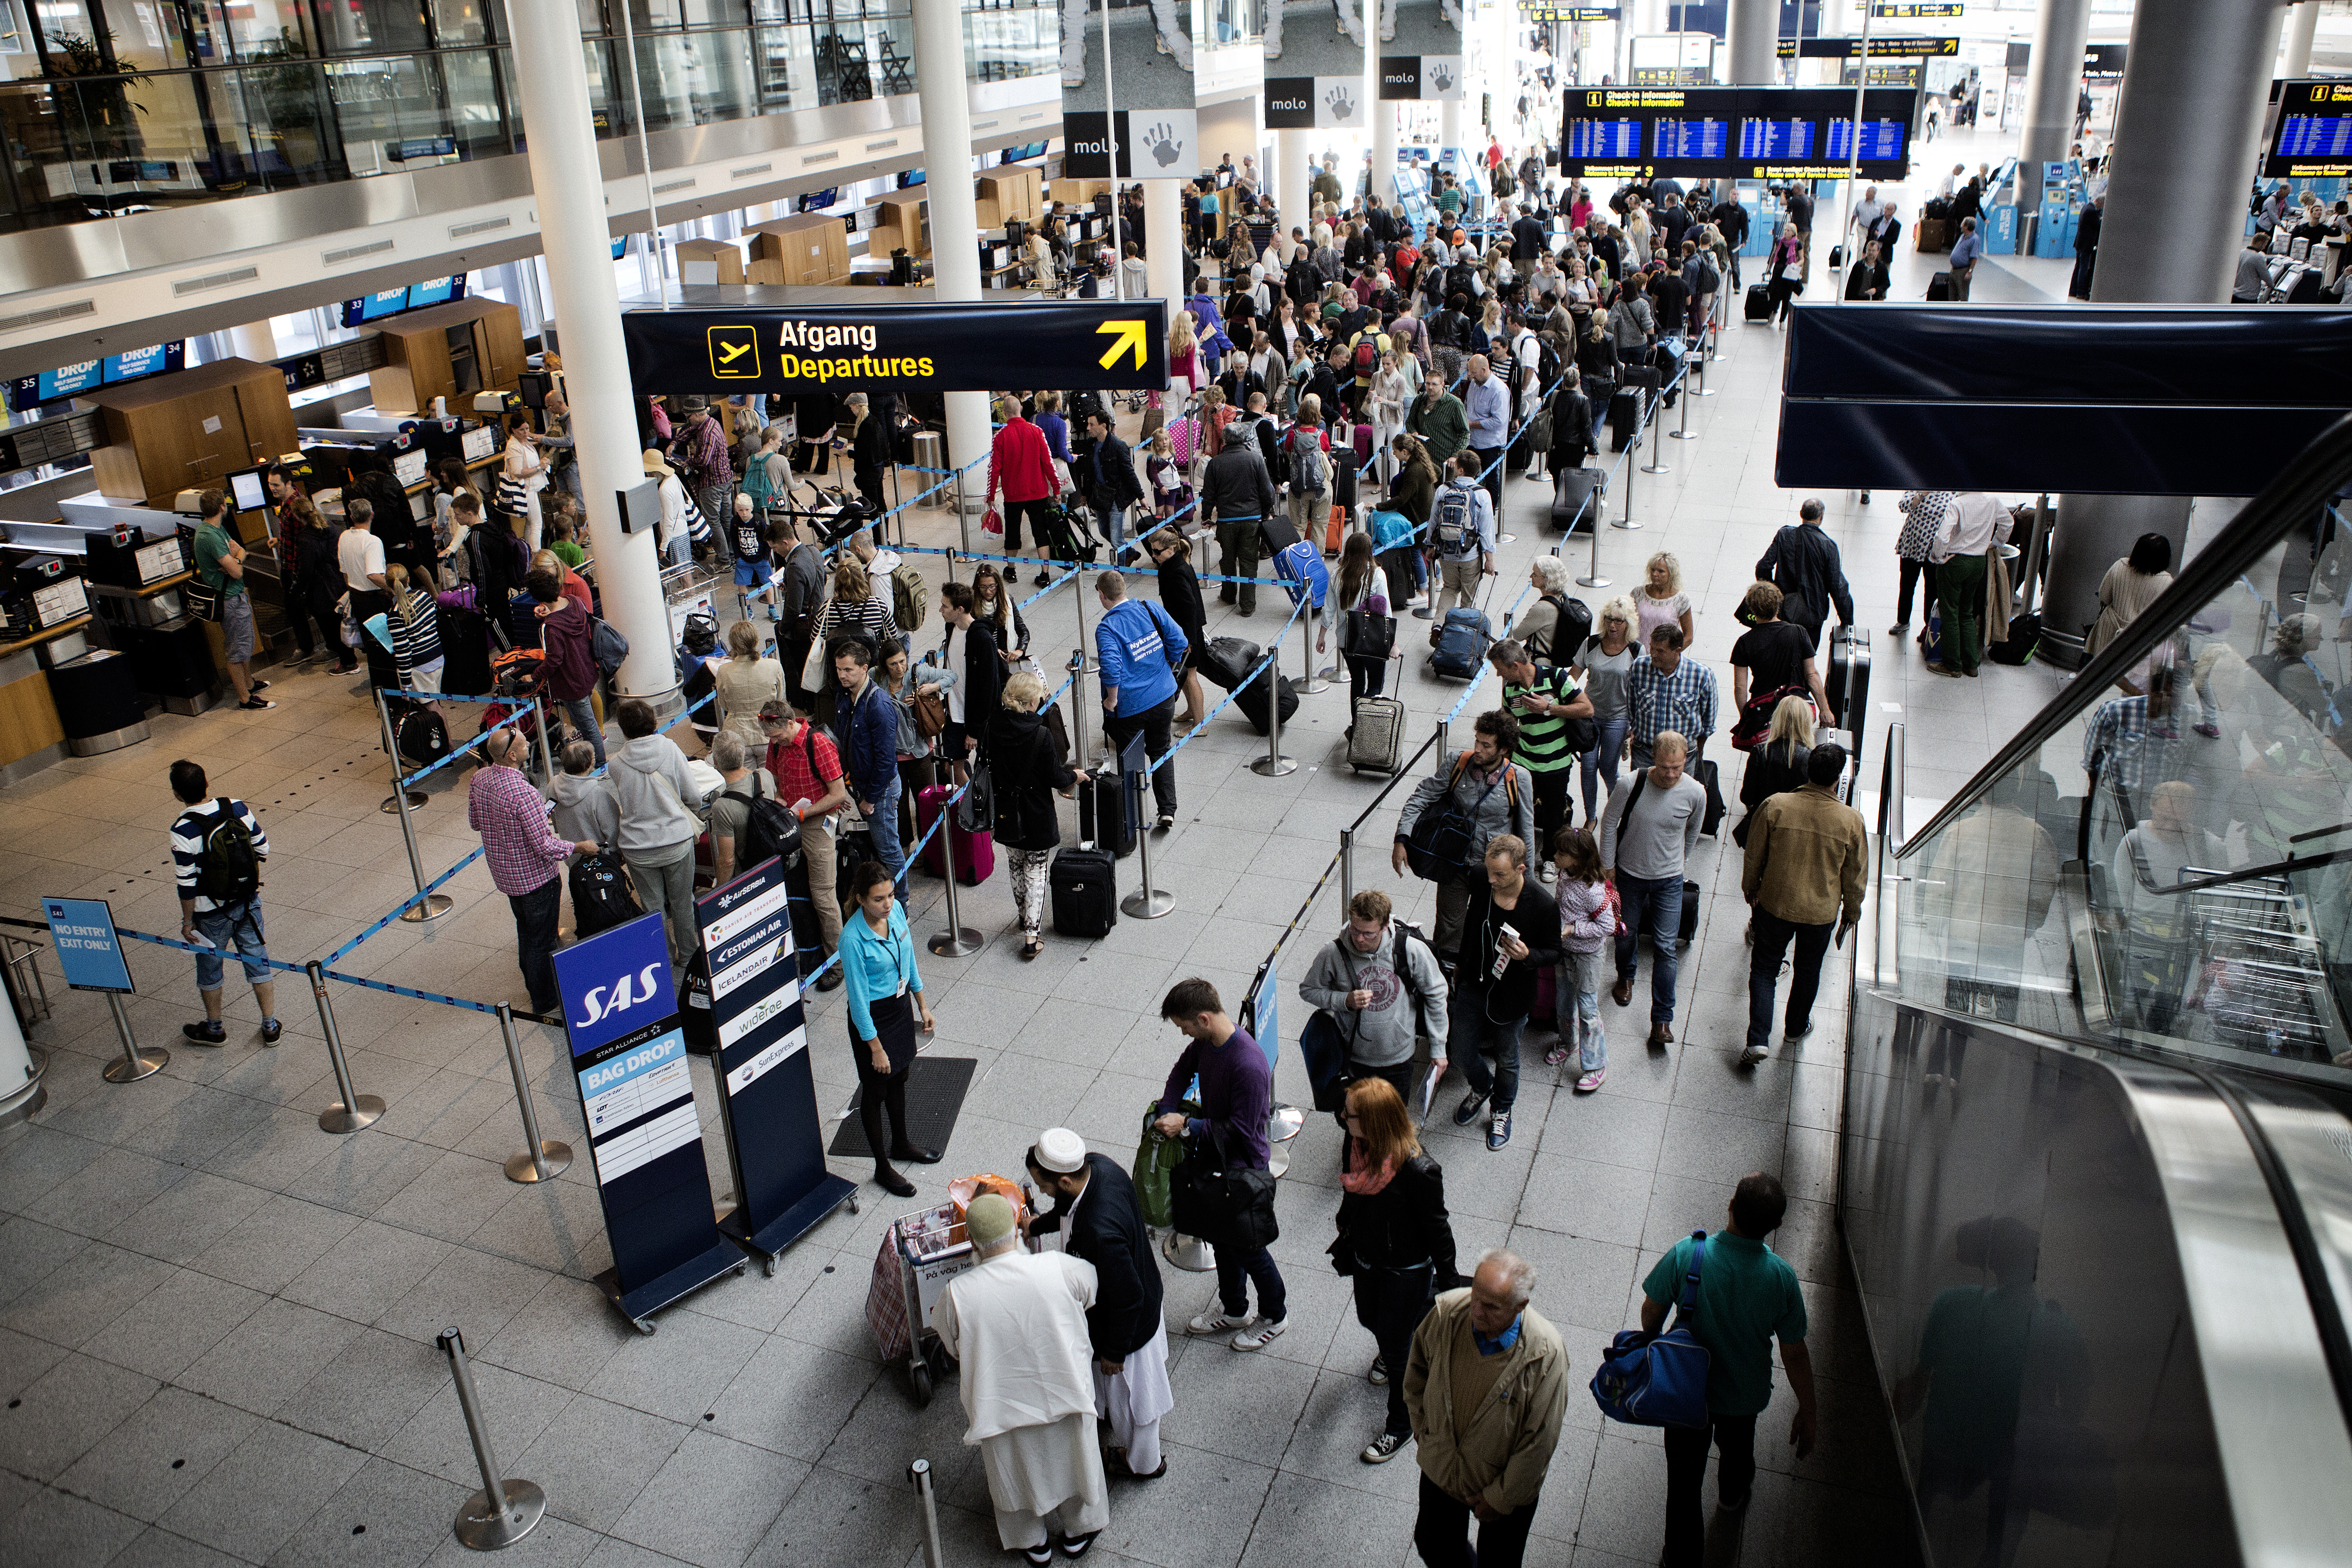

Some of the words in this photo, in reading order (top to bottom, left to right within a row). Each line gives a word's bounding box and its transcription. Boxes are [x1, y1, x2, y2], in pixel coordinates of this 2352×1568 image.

[1915, 5, 1920, 16] 1
[1386, 73, 1414, 83] molo
[1669, 71, 1675, 79] 2
[1882, 69, 1888, 78] 2
[1642, 91, 1685, 99] Information
[1272, 98, 1306, 110] molo
[1645, 166, 1653, 177] 3
[422, 276, 450, 290] DROP
[453, 277, 463, 286] 32
[377, 287, 405, 302] DROP
[352, 300, 362, 309] 33
[780, 321, 877, 353] Afgang
[122, 344, 162, 362] DROP
[168, 343, 180, 353] 34
[58, 360, 98, 378] DROP
[781, 353, 934, 383] Departures
[22, 378, 36, 389] 35
[1134, 650, 1152, 662] SPARTA
[732, 877, 765, 901] AirSERBIA
[725, 917, 743, 930] DANISH
[754, 894, 781, 913] TRANSPORT
[54, 925, 71, 934] NO
[72, 926, 106, 937] ENTRY
[59, 938, 82, 948] EXIT
[84, 940, 110, 951] ONLY
[727, 928, 767, 958] ESTONIAN
[768, 919, 782, 934] AIR
[718, 956, 768, 991] ICELANDAIR
[577, 962, 661, 1028] SAS
[739, 1000, 782, 1033] widerøe
[1258, 1008, 1268, 1040] SAS
[1269, 992, 1275, 1016] GO
[596, 1047, 614, 1058] STAR
[615, 1032, 648, 1050] ALLIANCE
[759, 1041, 794, 1069] SunExpress
[588, 1062, 625, 1090] BAG
[626, 1039, 675, 1073] DROP
[656, 1072, 679, 1084] Lufthansa
[597, 1104, 608, 1112] LOT
[926, 1271, 938, 1280] På
[940, 1266, 958, 1275] väg
